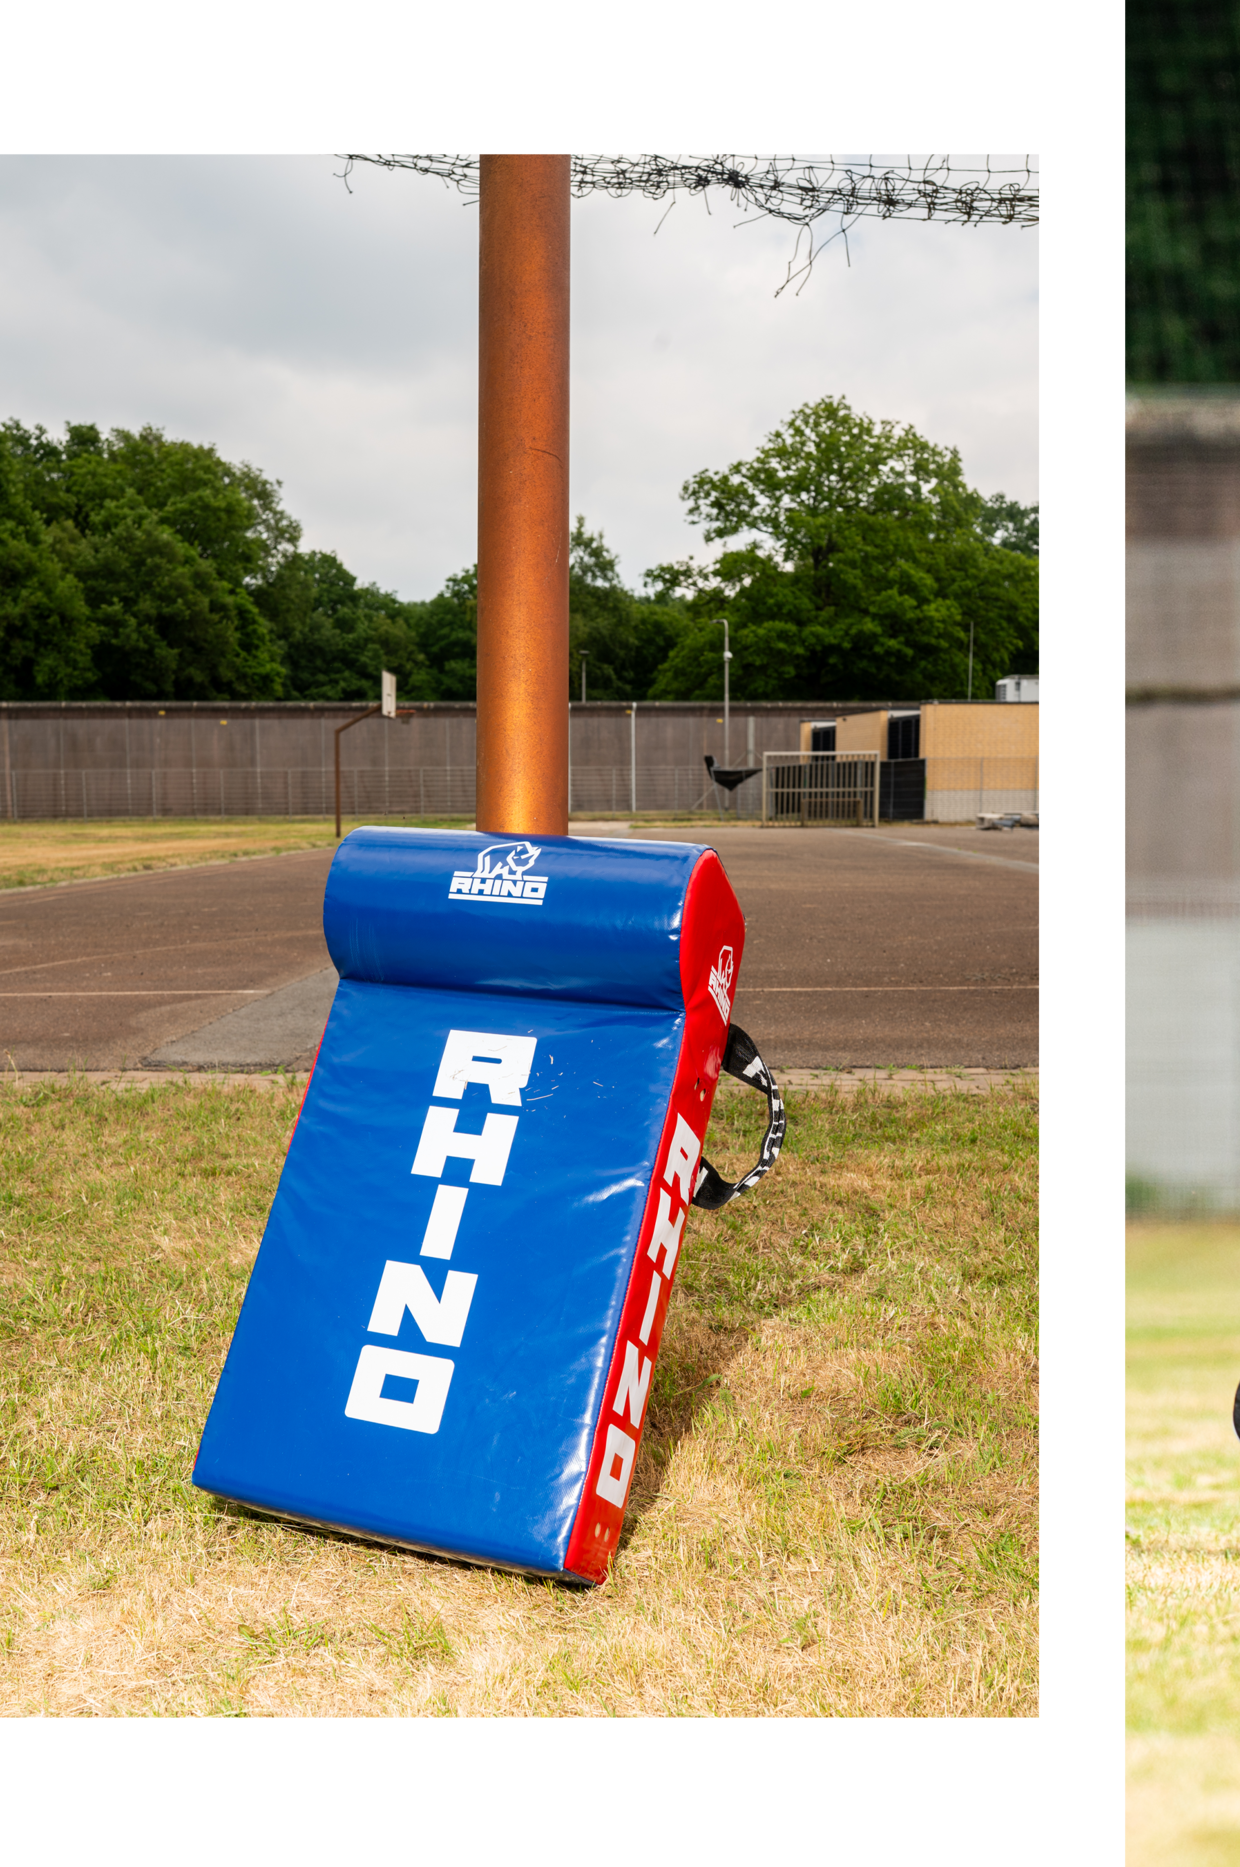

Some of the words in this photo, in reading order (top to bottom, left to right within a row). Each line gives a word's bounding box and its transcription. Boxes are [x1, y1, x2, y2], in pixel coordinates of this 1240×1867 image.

[449, 877, 547, 899] RHINO
[709, 972, 730, 1020] RHINO
[345, 1030, 538, 1434] RHINO
[597, 1113, 701, 1508] RHINO
